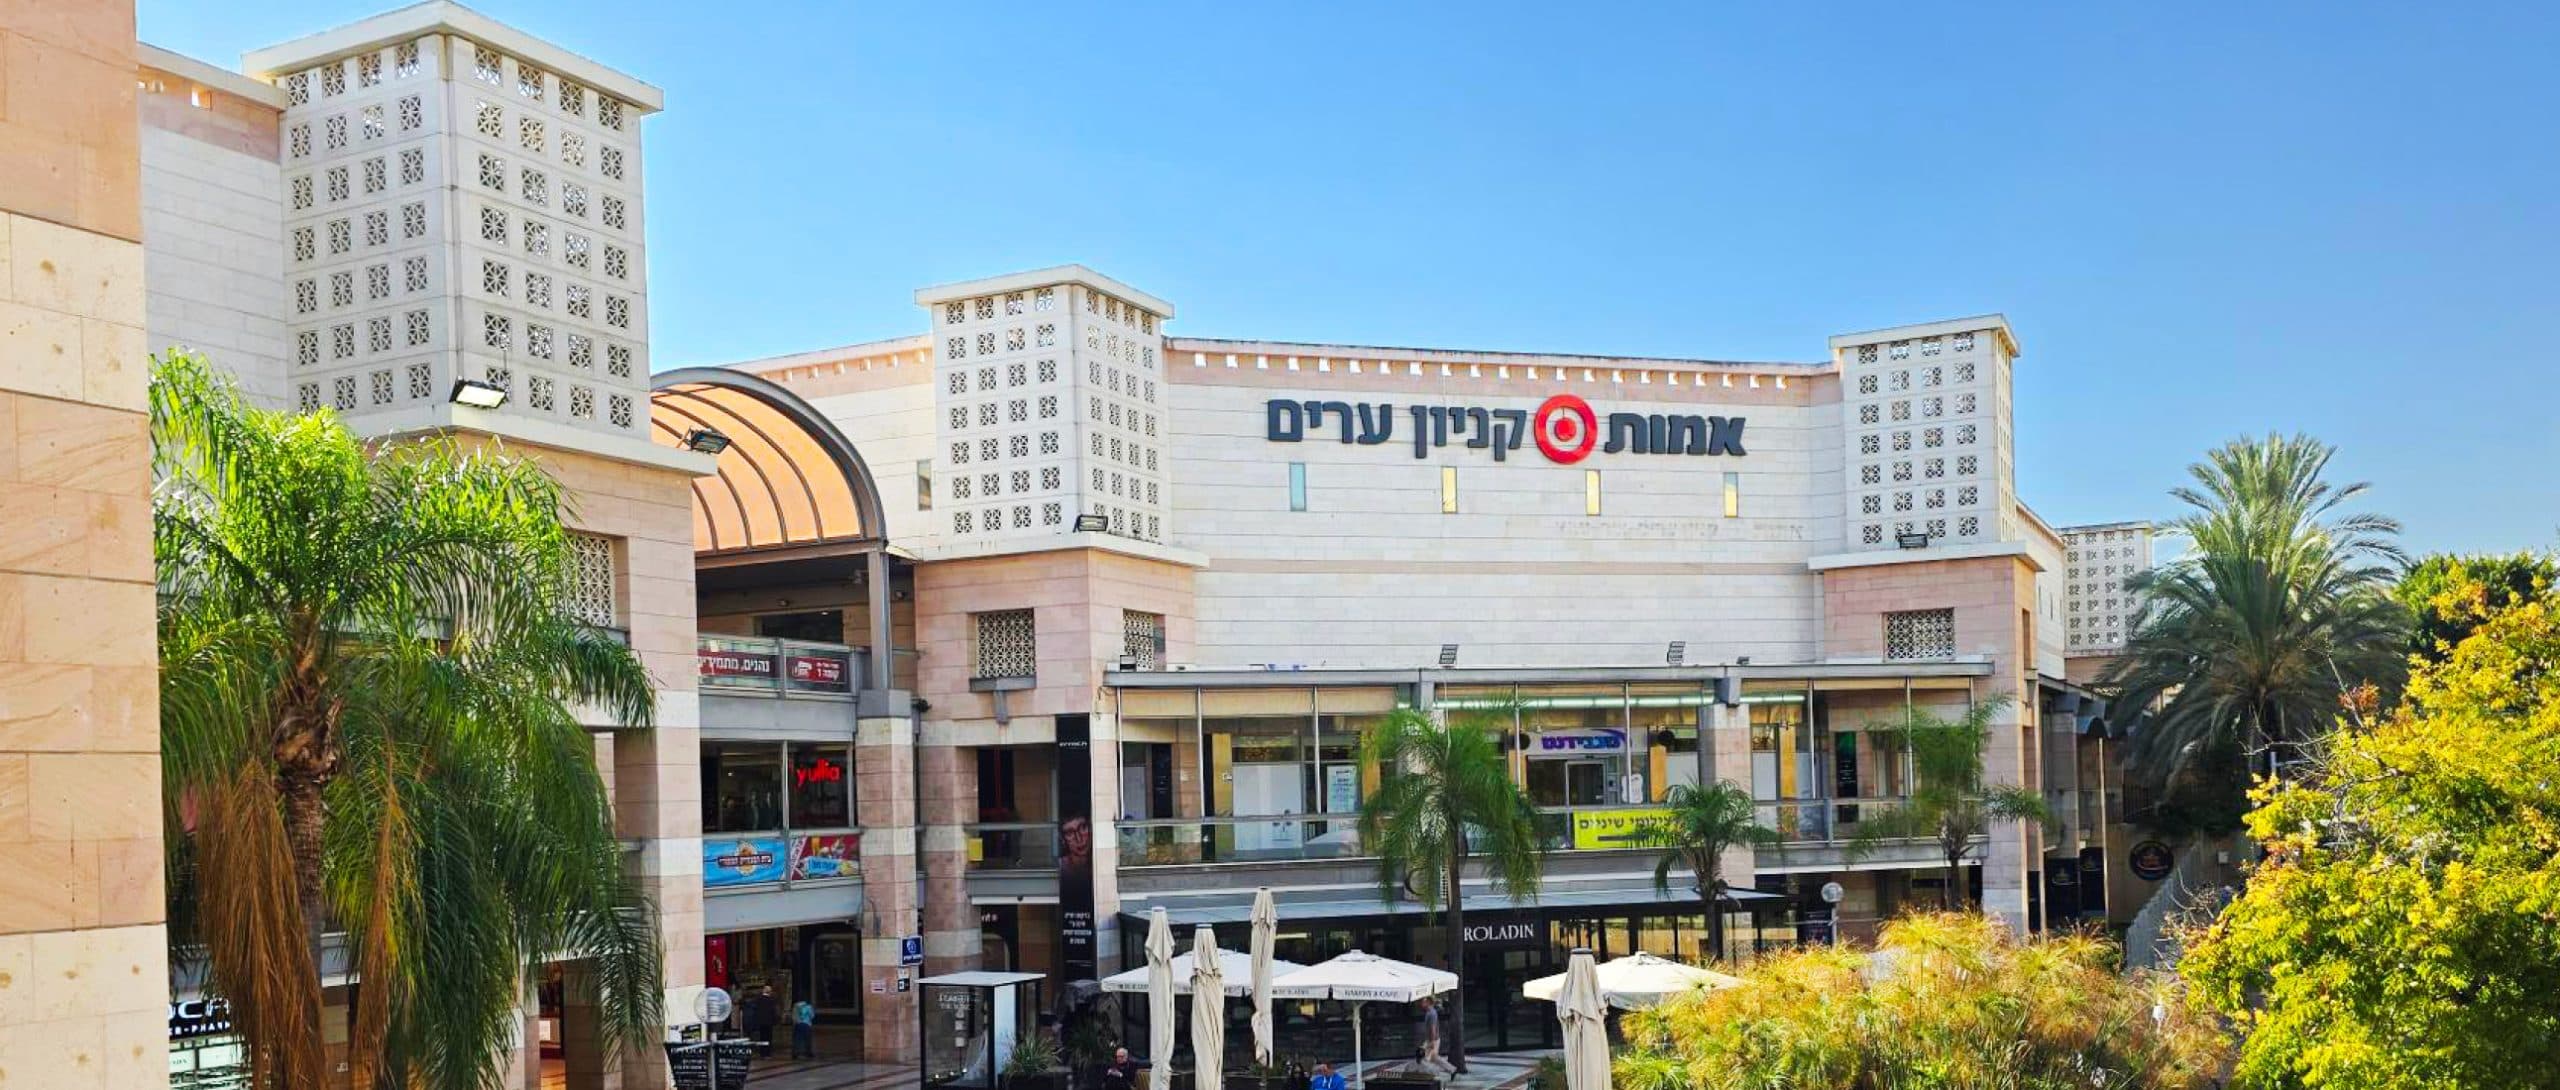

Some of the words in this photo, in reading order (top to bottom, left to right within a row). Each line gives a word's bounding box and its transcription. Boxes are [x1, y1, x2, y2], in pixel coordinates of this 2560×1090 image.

[1267, 398, 1393, 445] ערים
[1410, 404, 1527, 462] קניון
[1604, 411, 1748, 457] אמות
[1579, 816, 1625, 830] שיניים
[1464, 924, 1534, 942] ROLADIN
